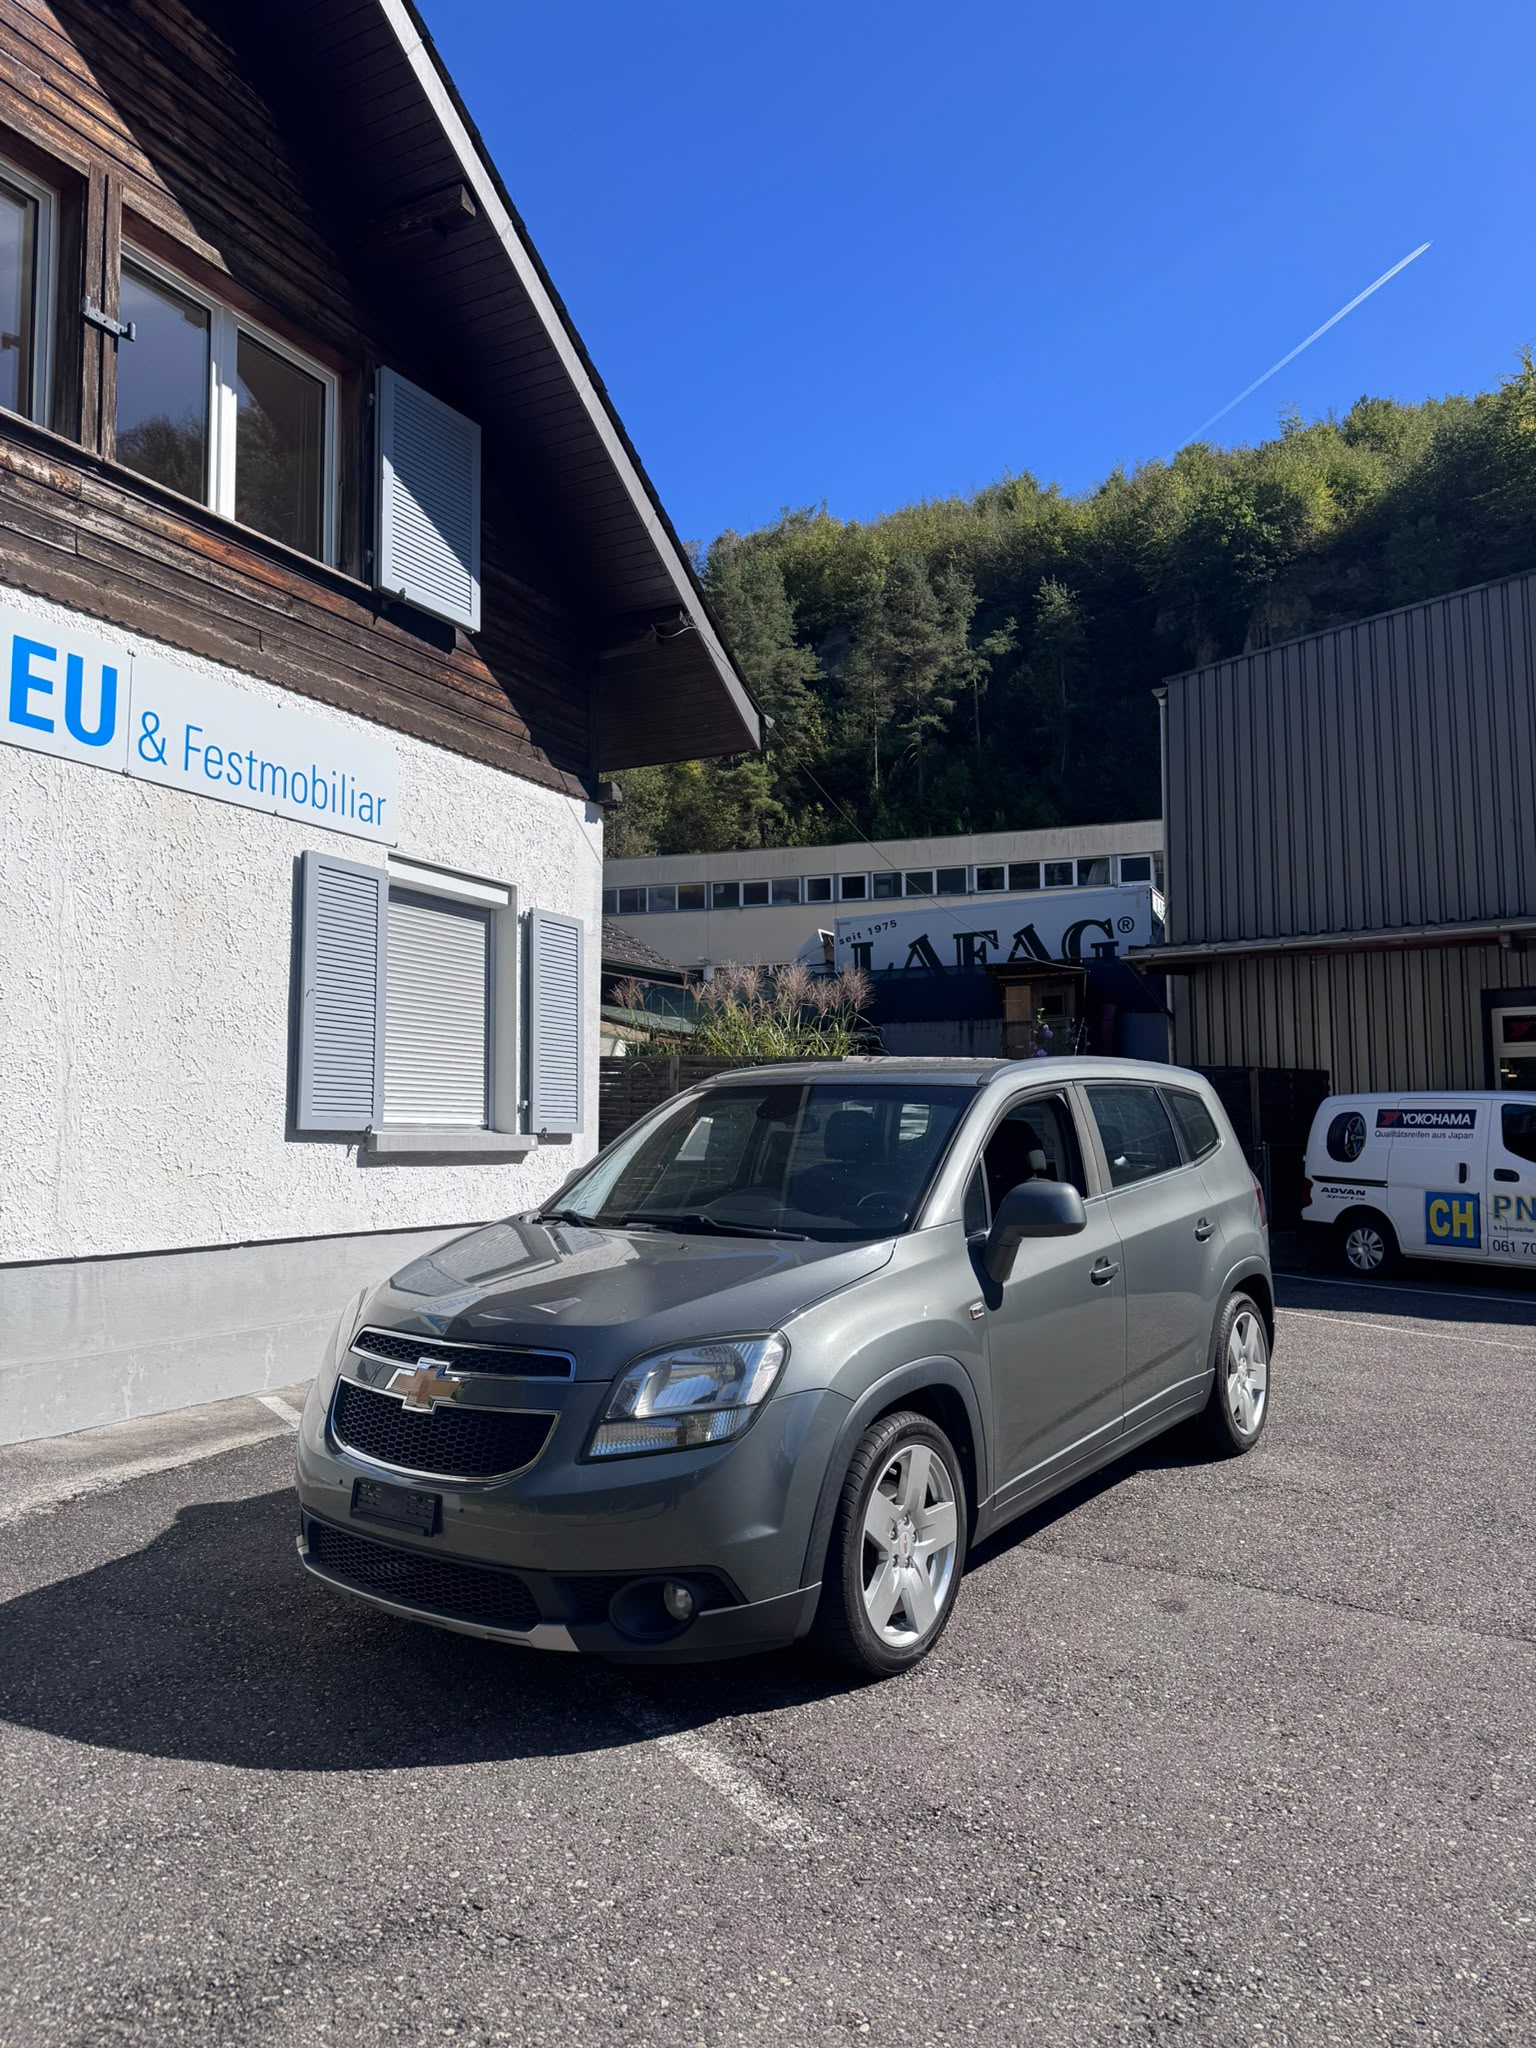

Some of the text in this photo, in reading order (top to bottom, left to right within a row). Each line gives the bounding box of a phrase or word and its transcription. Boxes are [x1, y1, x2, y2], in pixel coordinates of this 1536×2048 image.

[8, 633, 387, 827] EU & Festmobiliar
[838, 919, 898, 945] seit 1975
[1401, 1112, 1471, 1126] YOKOHAMA
[1374, 1129, 1474, 1141] Qualitätsreifen aus Japan
[1320, 1186, 1366, 1196] ADVAN
[1428, 1198, 1475, 1239] CH
[1492, 1239, 1516, 1253] 061
